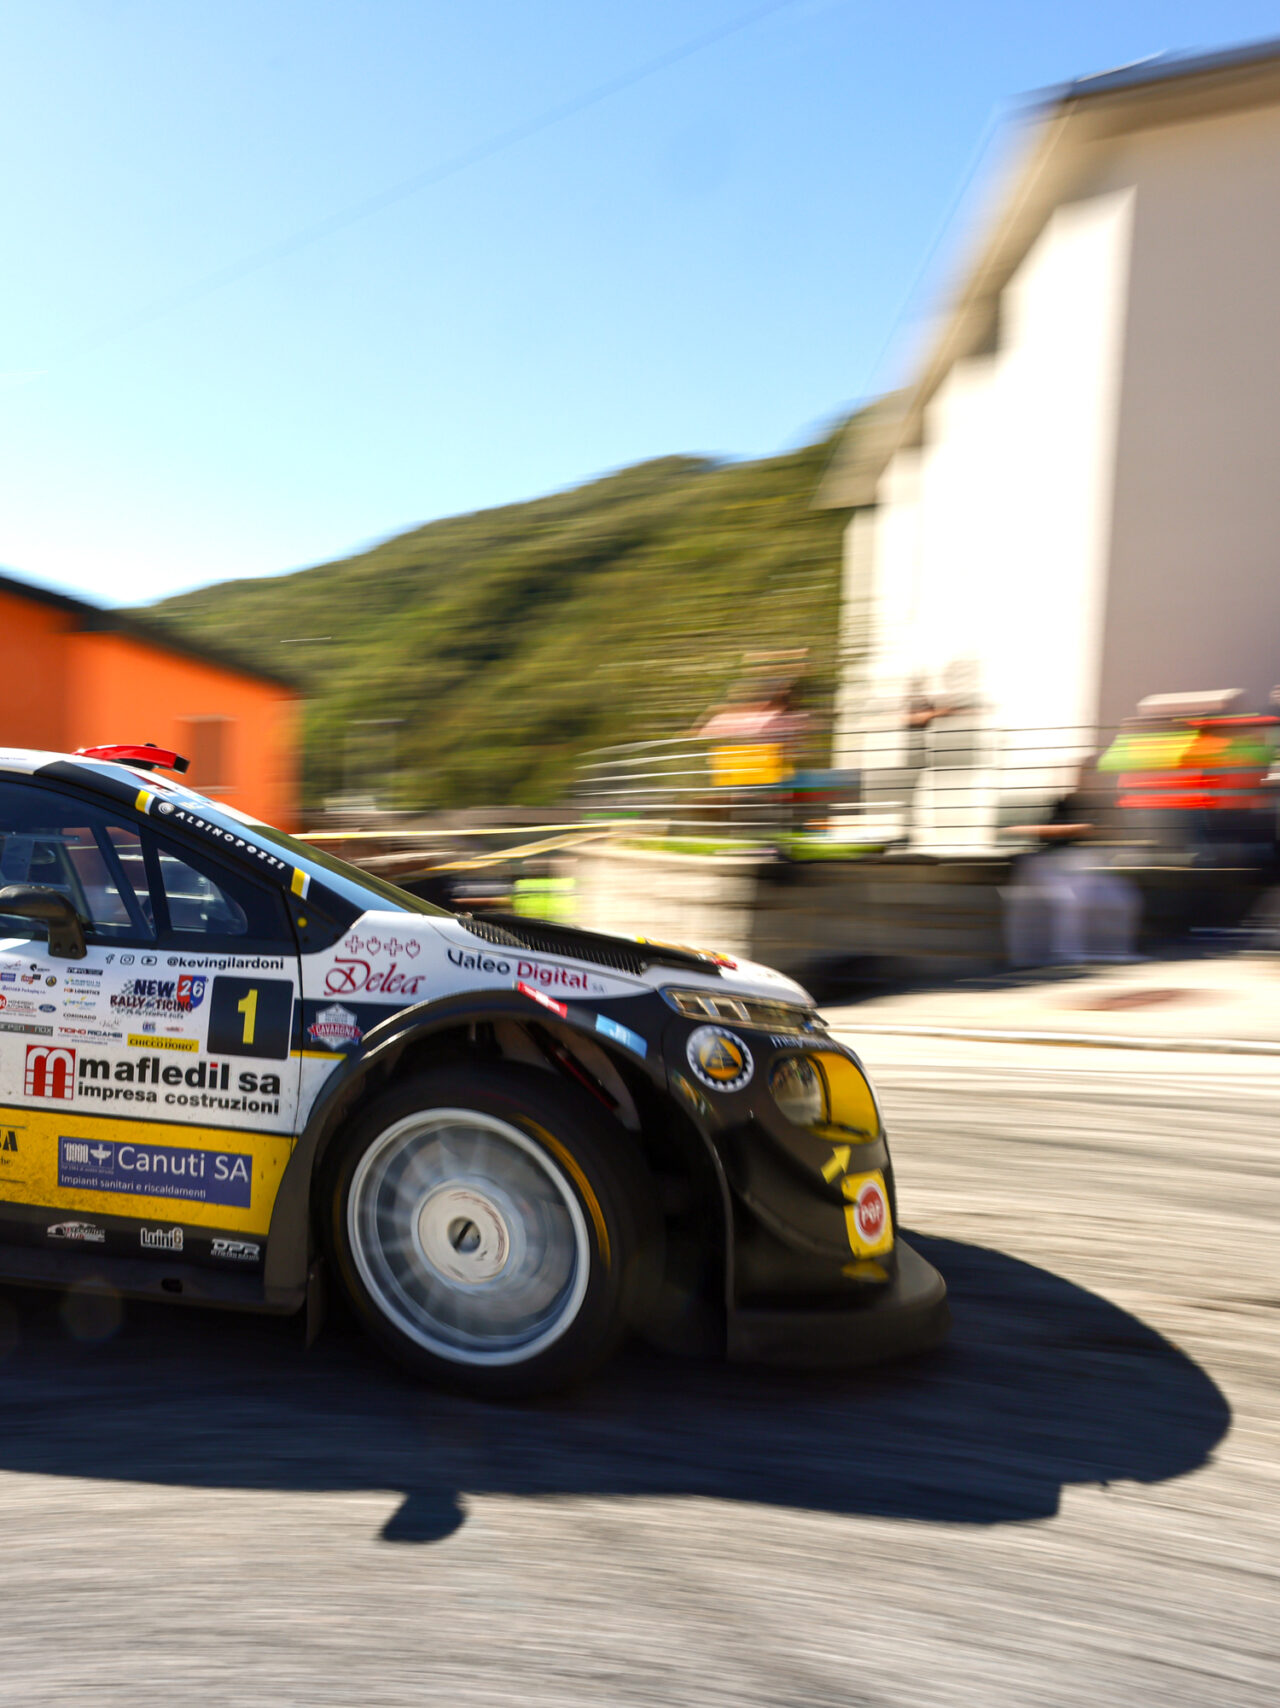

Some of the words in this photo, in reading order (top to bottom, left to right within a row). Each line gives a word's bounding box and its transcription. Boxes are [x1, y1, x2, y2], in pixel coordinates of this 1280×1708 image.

[175, 811, 286, 870] ALBINOPOZZI
[167, 956, 284, 970] @kevingilardoni
[516, 961, 589, 990] Digital
[110, 995, 148, 1009] RALLY
[155, 999, 194, 1013] TICINO
[133, 979, 176, 997] NEW
[180, 980, 204, 998] 26
[237, 988, 258, 1045] 1
[78, 1056, 230, 1091] mafledil
[238, 1070, 281, 1095] sa
[78, 1081, 158, 1103] impresa
[165, 1092, 280, 1114] costruzioni
[118, 1146, 206, 1178] Canuti
[214, 1155, 249, 1183] SA
[61, 1174, 98, 1188] Impianti
[100, 1178, 134, 1191] sanitari
[136, 1183, 142, 1191] e
[144, 1183, 206, 1199] riscaldamenti
